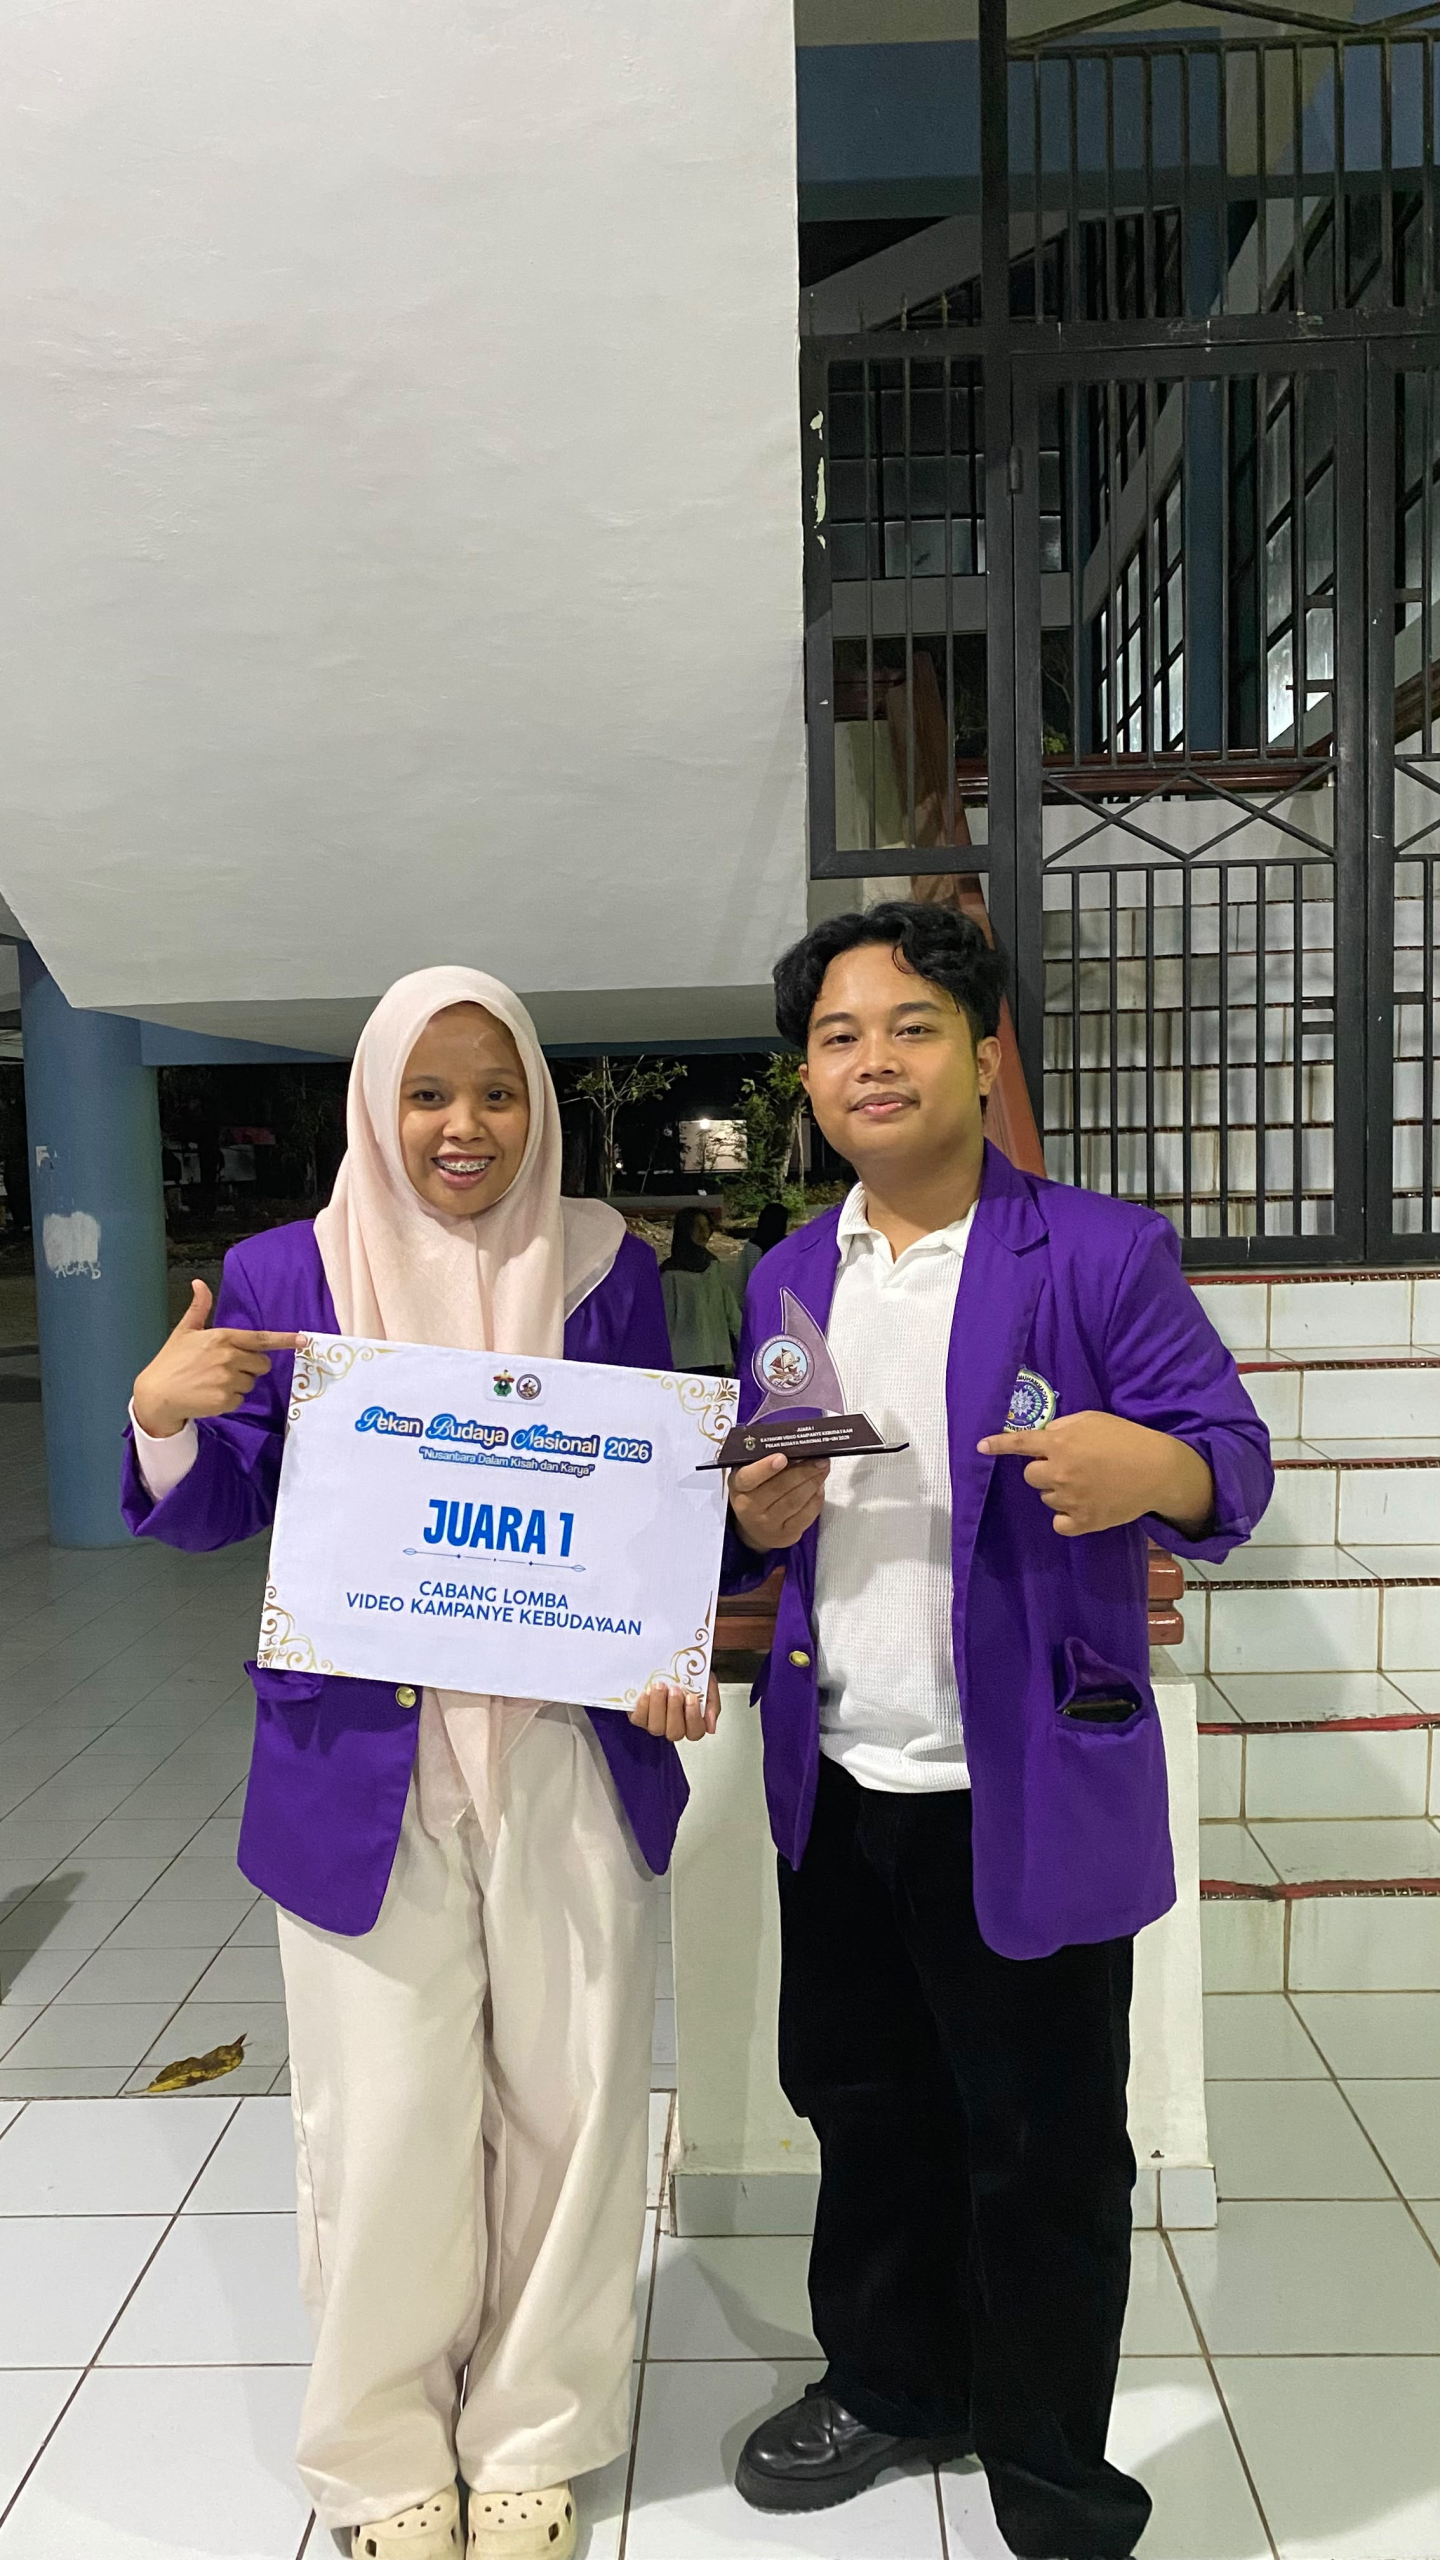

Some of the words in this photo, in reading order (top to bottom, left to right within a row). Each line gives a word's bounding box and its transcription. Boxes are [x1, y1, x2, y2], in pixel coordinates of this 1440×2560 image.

[356, 1407, 421, 1436] Pekan
[427, 1414, 507, 1448] Budaya
[512, 1425, 599, 1456] Nasional
[605, 1438, 651, 1461] 2026
[477, 1454, 509, 1467] Dalam
[510, 1456, 539, 1471] Kisah
[540, 1460, 559, 1473] dan
[423, 1498, 546, 1555] JUARA
[559, 1512, 574, 1558] 1
[346, 1592, 404, 1612] VIDEO
[410, 1598, 513, 1623] KAMPANYE
[519, 1609, 642, 1636] KEBUDAYAAN
[419, 1581, 497, 1602] CABANG
[503, 1588, 569, 1609] LOMBA
